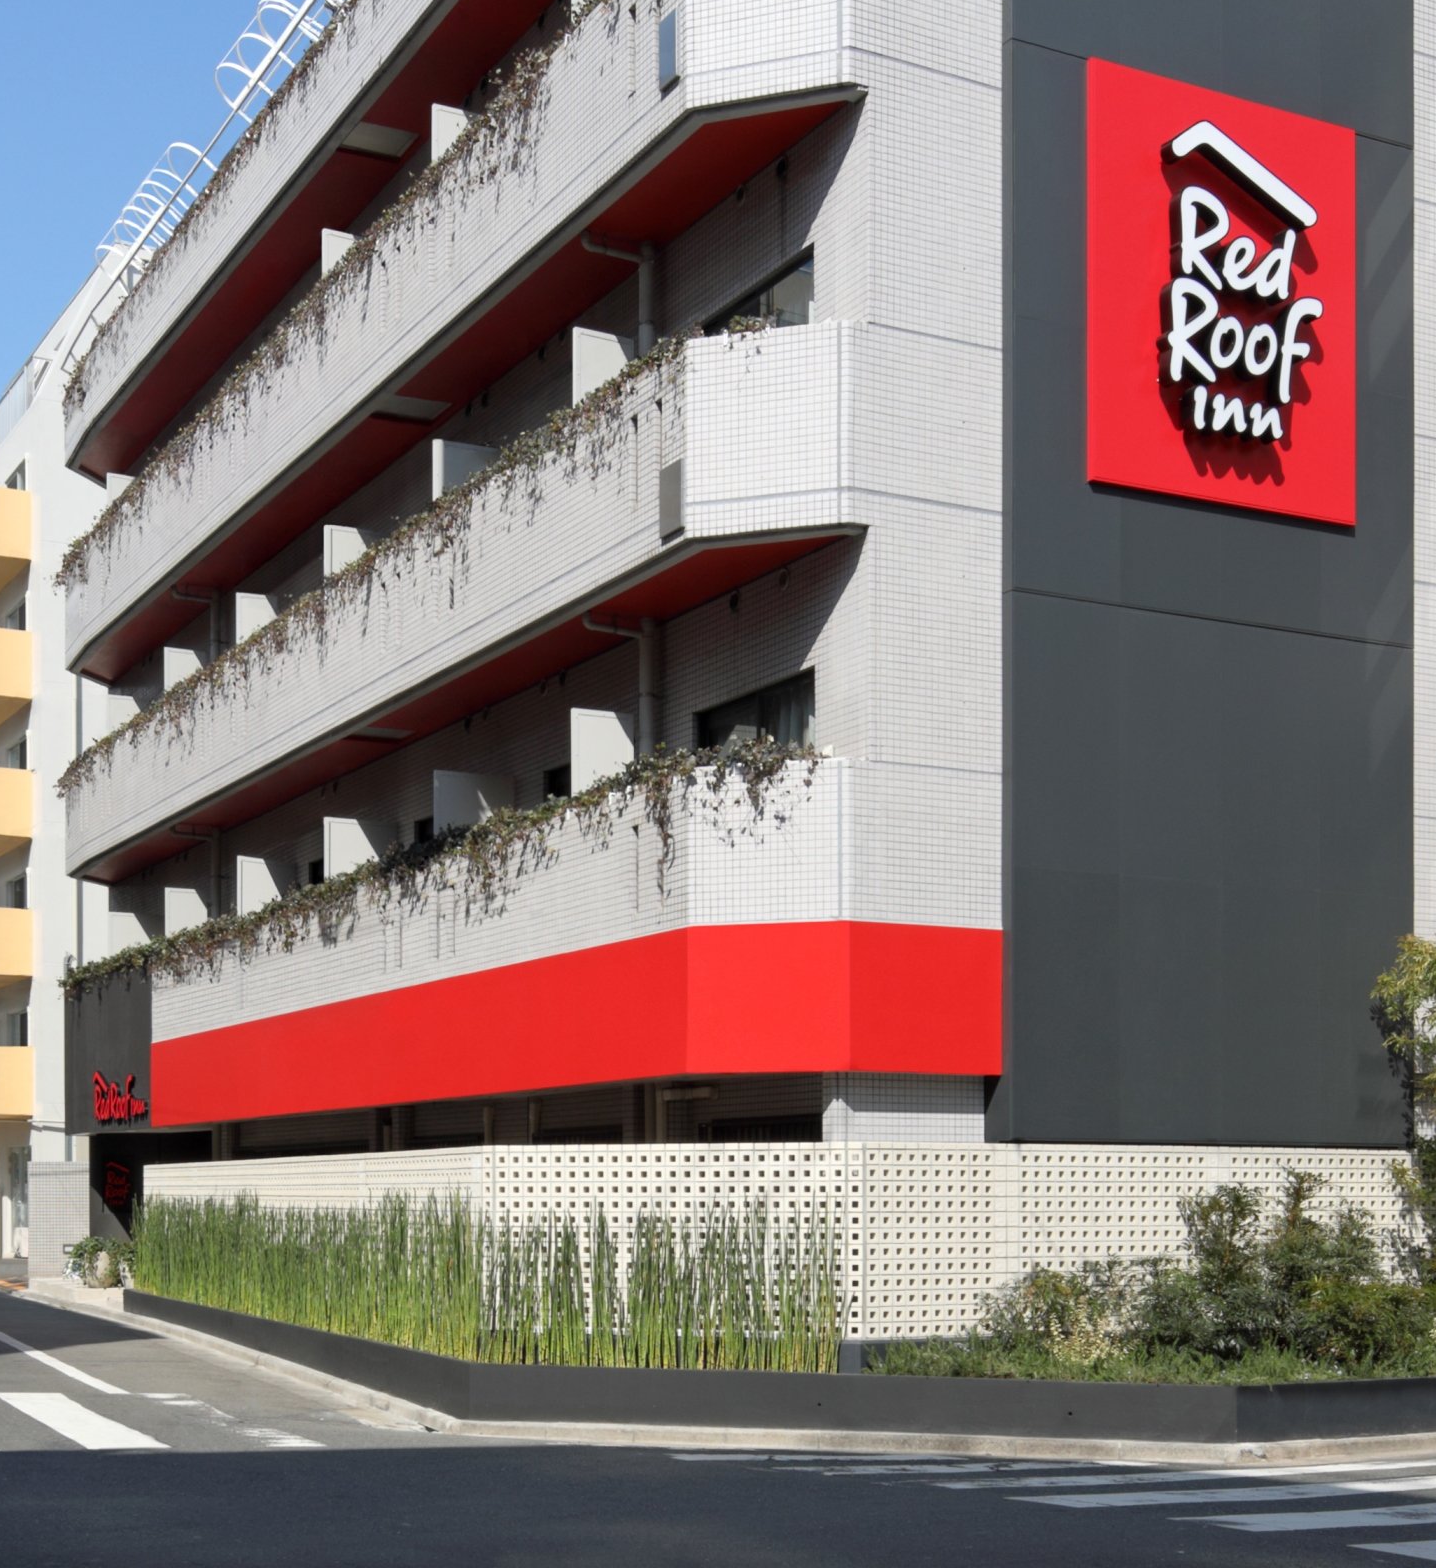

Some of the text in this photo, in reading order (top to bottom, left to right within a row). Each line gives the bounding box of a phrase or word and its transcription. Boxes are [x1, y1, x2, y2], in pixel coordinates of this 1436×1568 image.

[1179, 185, 1297, 300] Red
[1167, 277, 1324, 404] Roof
[93, 1085, 111, 1120] Red
[110, 1074, 134, 1120] Roof
